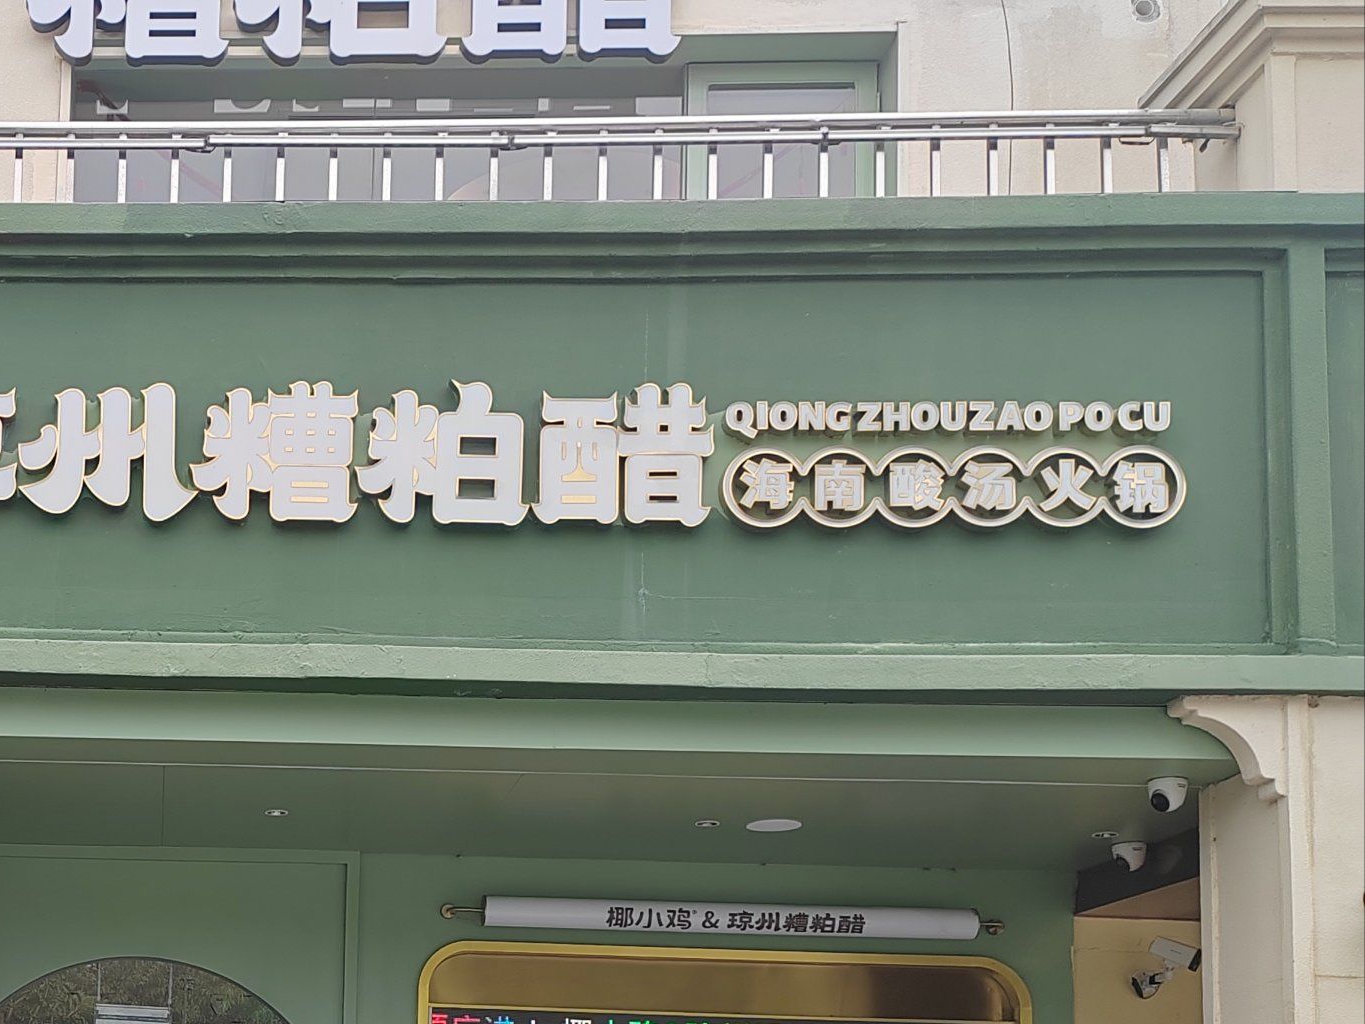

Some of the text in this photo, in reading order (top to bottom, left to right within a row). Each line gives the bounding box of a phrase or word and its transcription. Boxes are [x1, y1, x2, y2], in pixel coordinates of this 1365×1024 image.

[739, 458, 1170, 514] 海南酸汤火锅
[701, 911, 720, 930] &
[727, 911, 866, 936] 琼州糟粕醋
